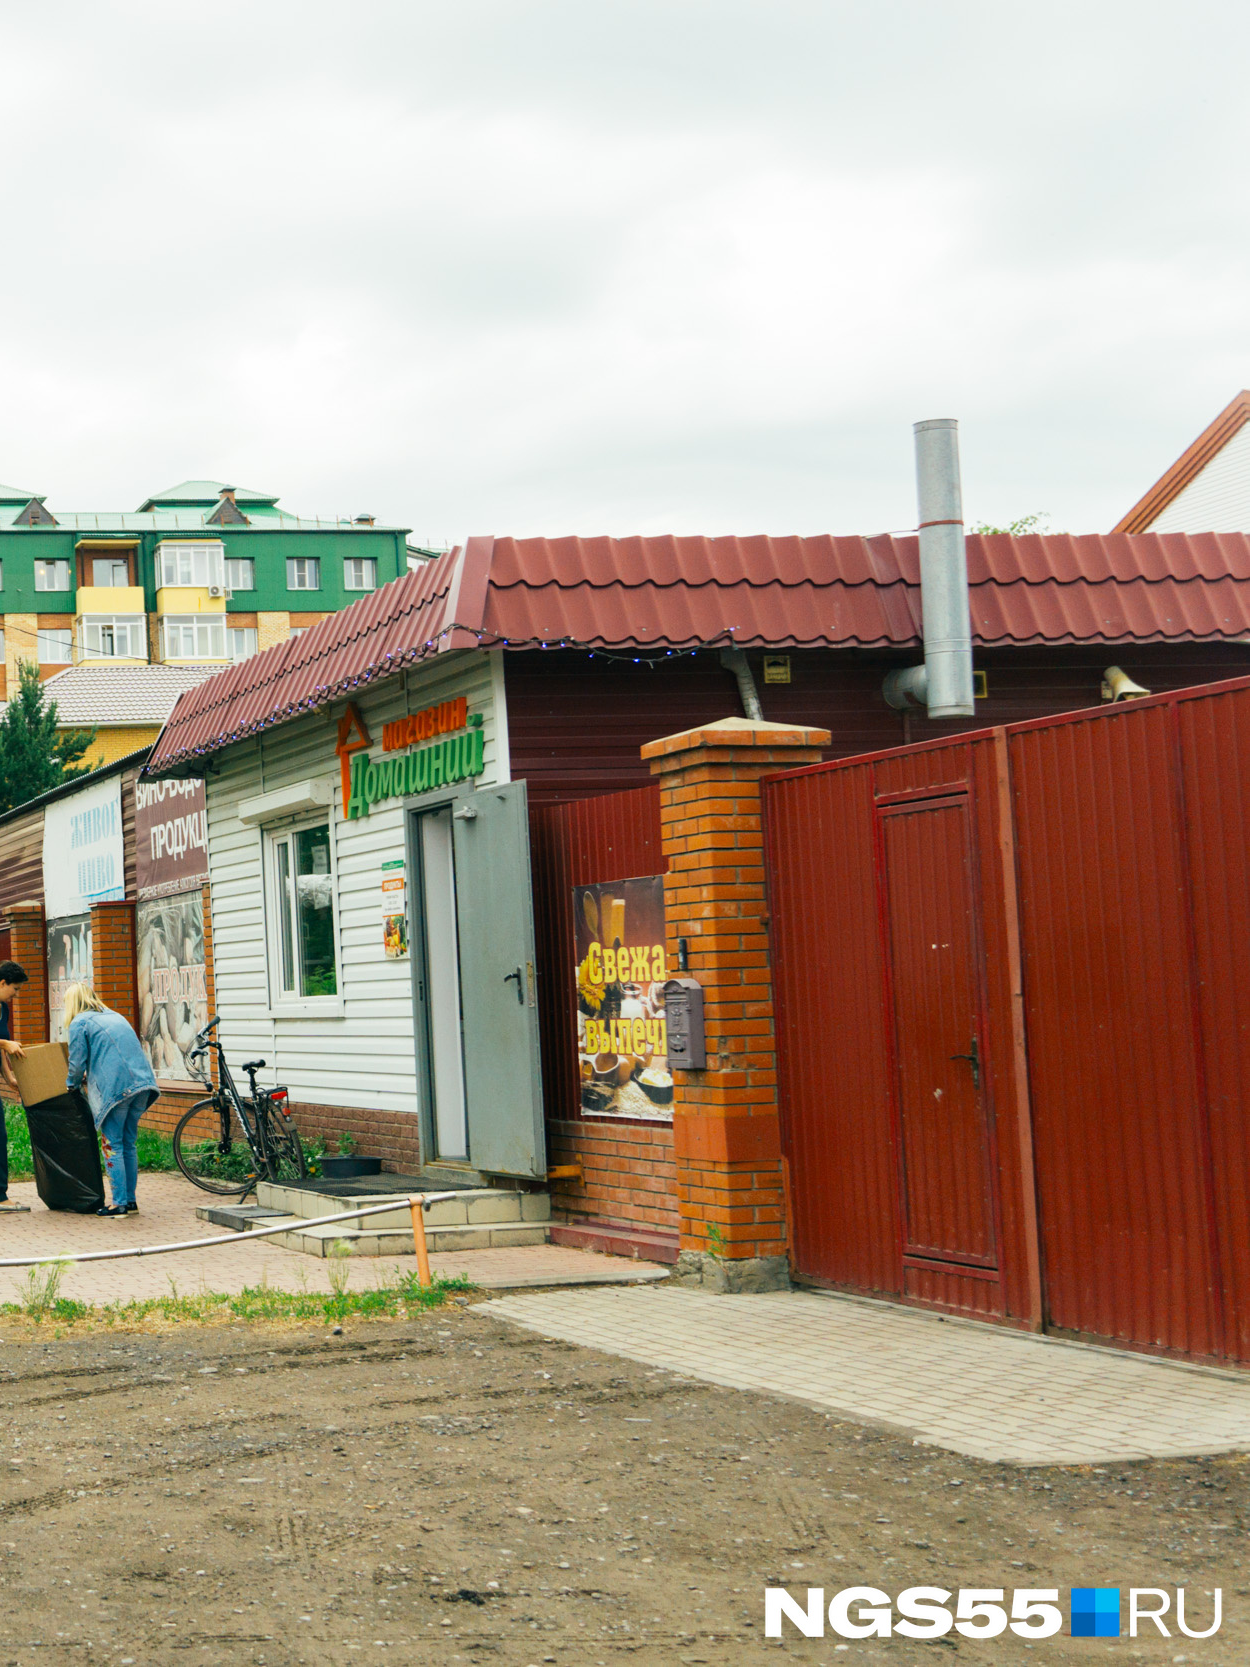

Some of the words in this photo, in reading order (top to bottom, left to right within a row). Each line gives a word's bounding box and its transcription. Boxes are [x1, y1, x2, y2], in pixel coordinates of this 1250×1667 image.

[383, 697, 467, 751] магазин
[348, 714, 484, 820] Домашний
[135, 779, 202, 811] ВИНО-В
[70, 797, 119, 849] ЖИВОЕ
[151, 809, 208, 861] ПРОДУКЦ
[588, 941, 667, 984] Свежа
